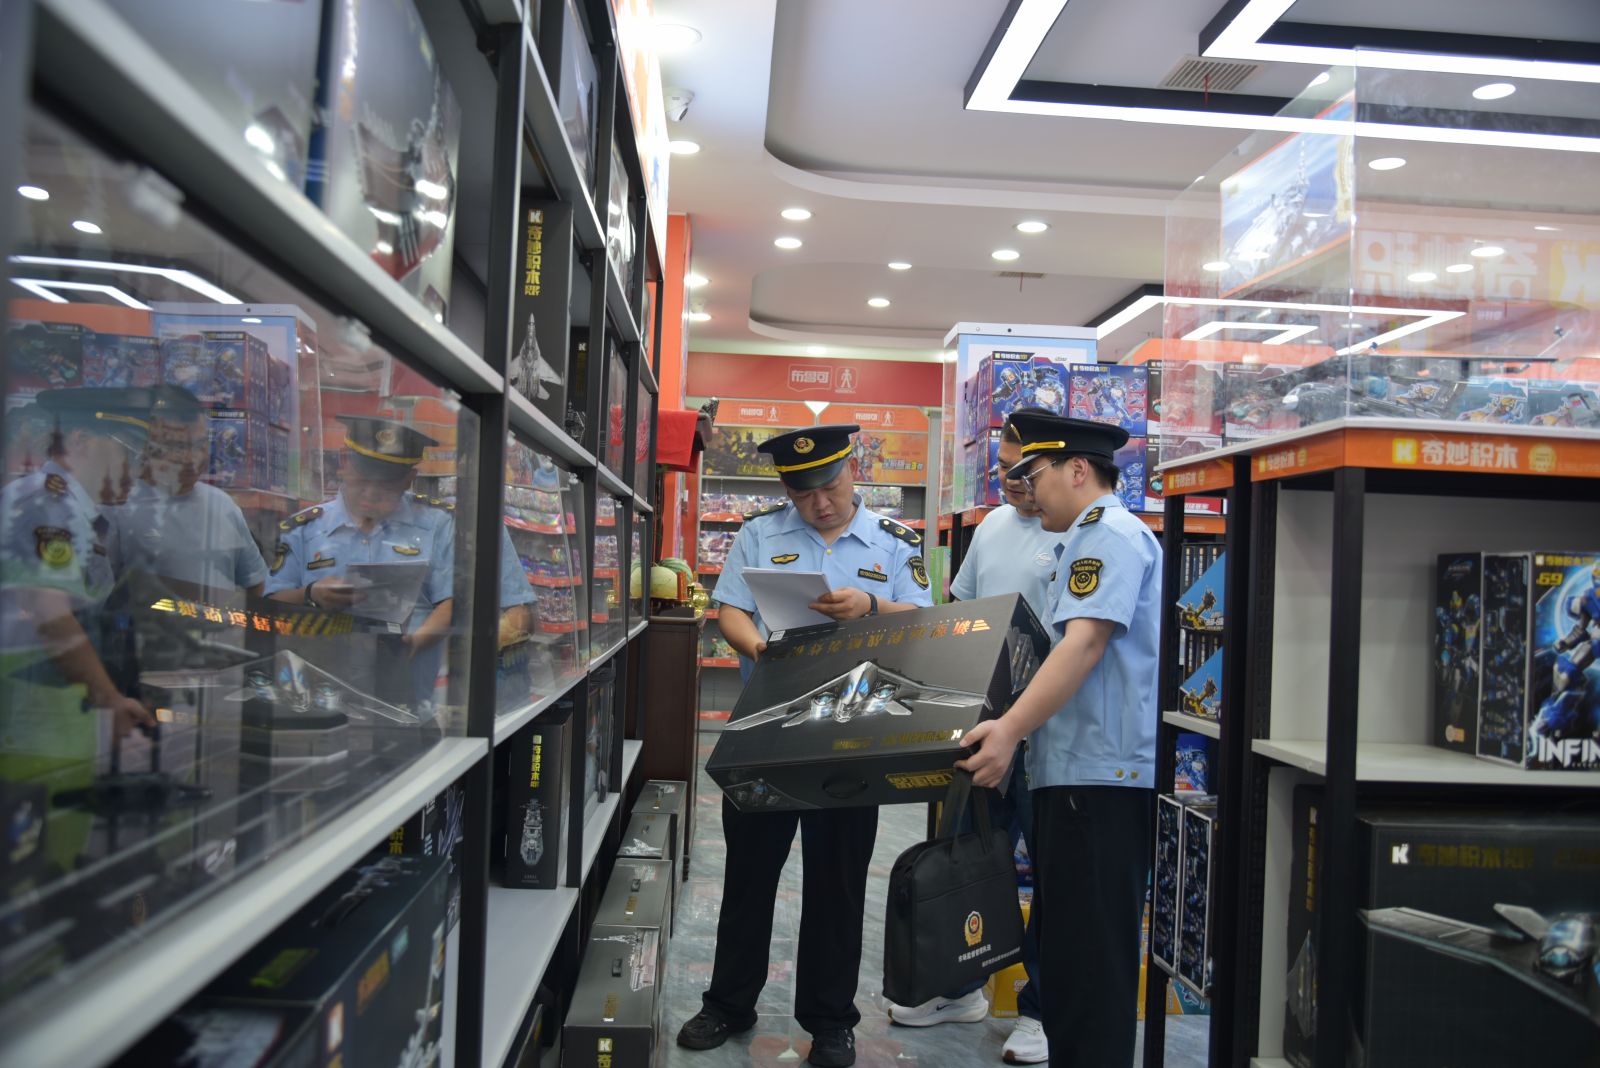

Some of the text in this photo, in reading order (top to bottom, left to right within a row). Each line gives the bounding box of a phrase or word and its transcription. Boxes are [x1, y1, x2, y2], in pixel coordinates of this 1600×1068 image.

[526, 226, 542, 284] 奇妙积木
[1421, 440, 1518, 469] 奇妙积木
[1392, 844, 1409, 864] K
[599, 1038, 612, 1052] K
